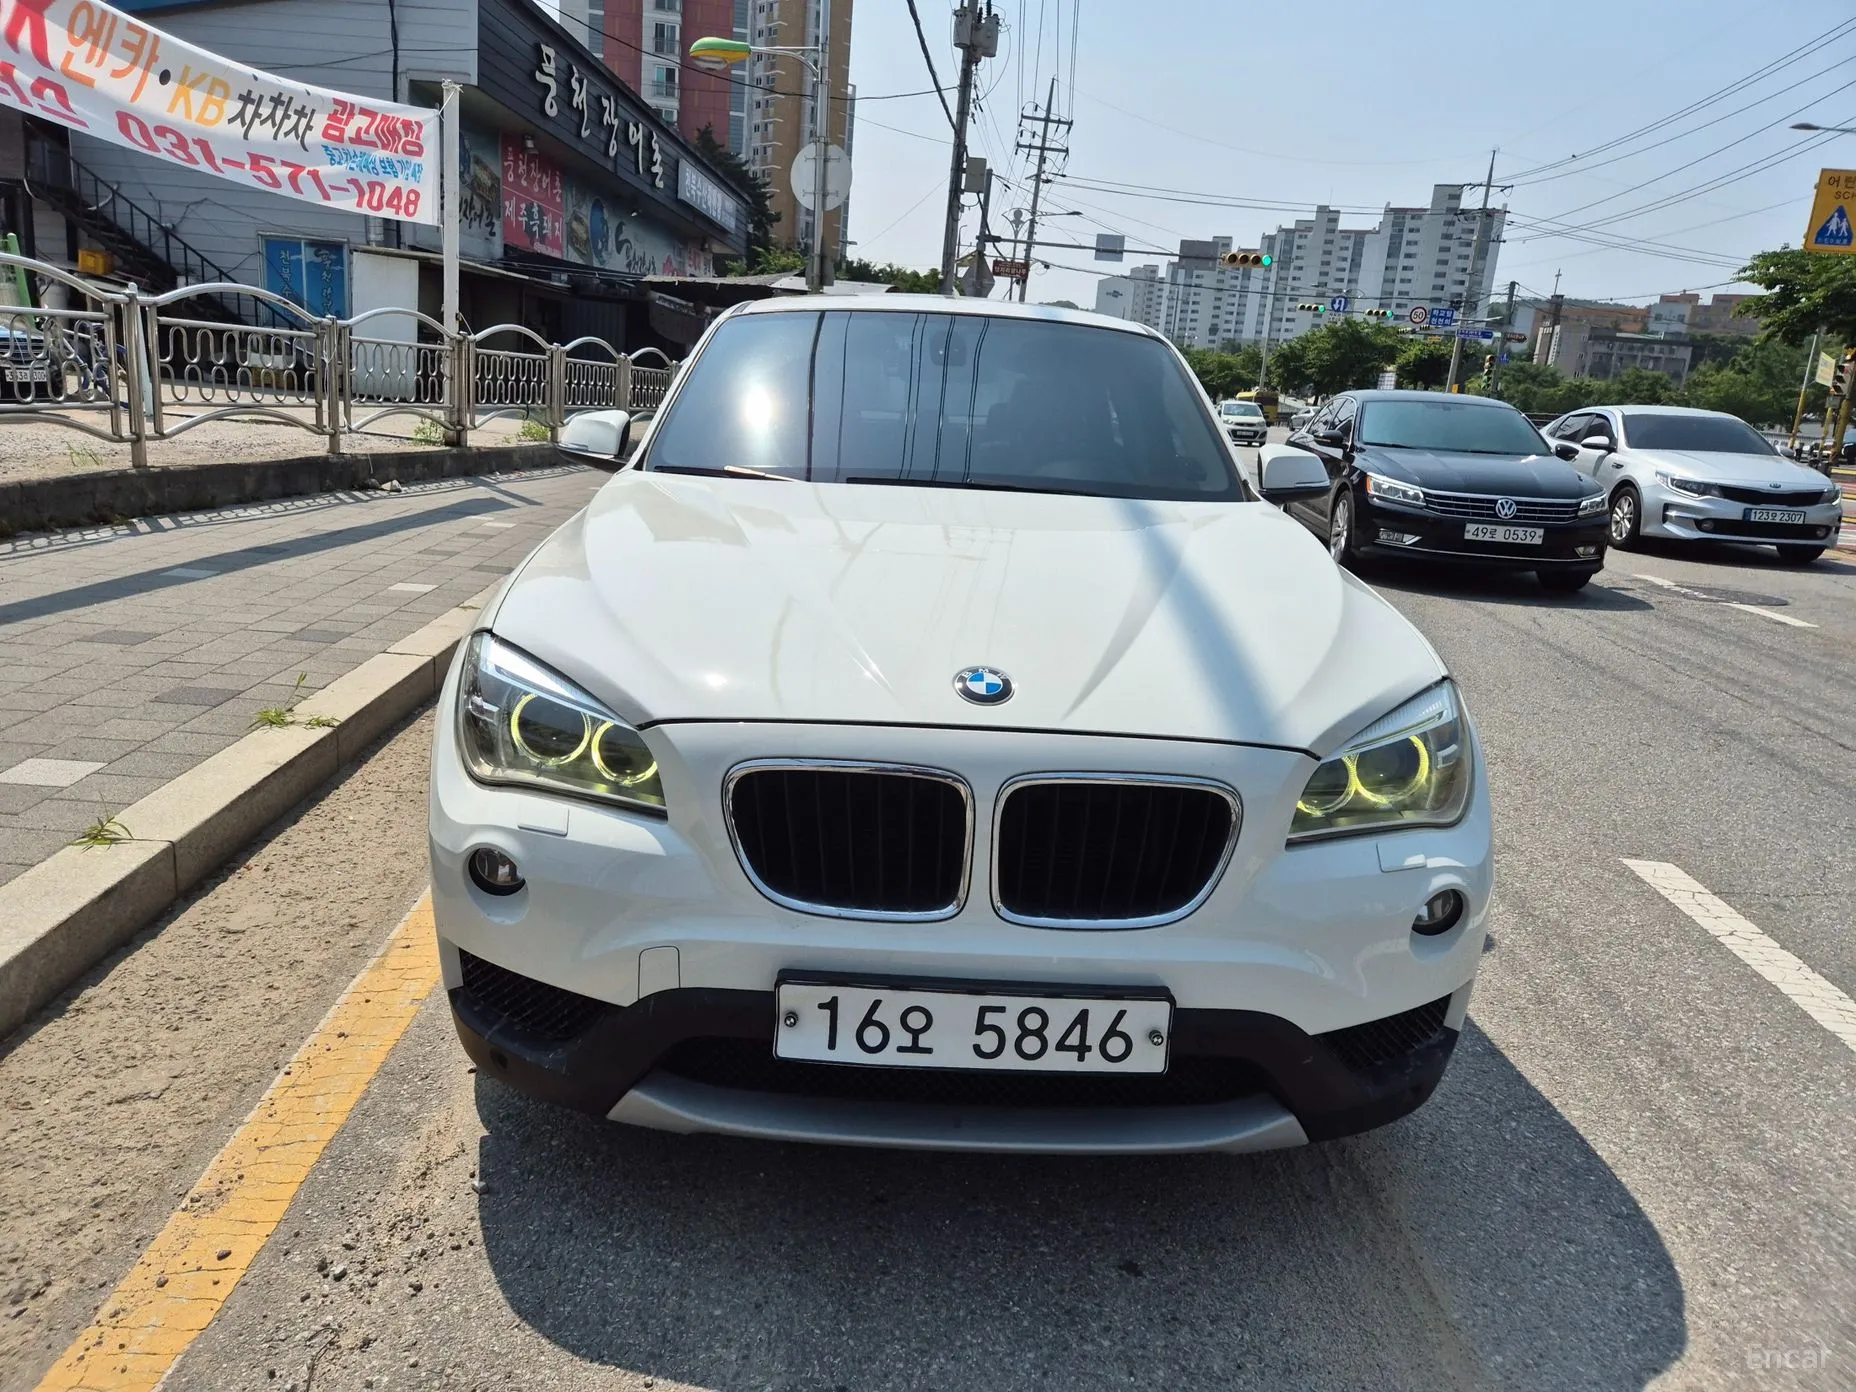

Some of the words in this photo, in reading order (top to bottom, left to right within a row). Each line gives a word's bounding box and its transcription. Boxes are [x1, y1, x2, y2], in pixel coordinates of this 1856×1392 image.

[321, 97, 425, 158] 광고매장
[535, 43, 664, 189] 풍천장어촌
[116, 110, 422, 218] 031-571-1048
[1412, 310, 1425, 320] 50
[1471, 526, 1498, 539] 49로
[1503, 528, 1537, 542] 0539
[1779, 512, 1803, 523] 2307
[817, 995, 934, 1055] 16오
[972, 1005, 1133, 1064] 5846
